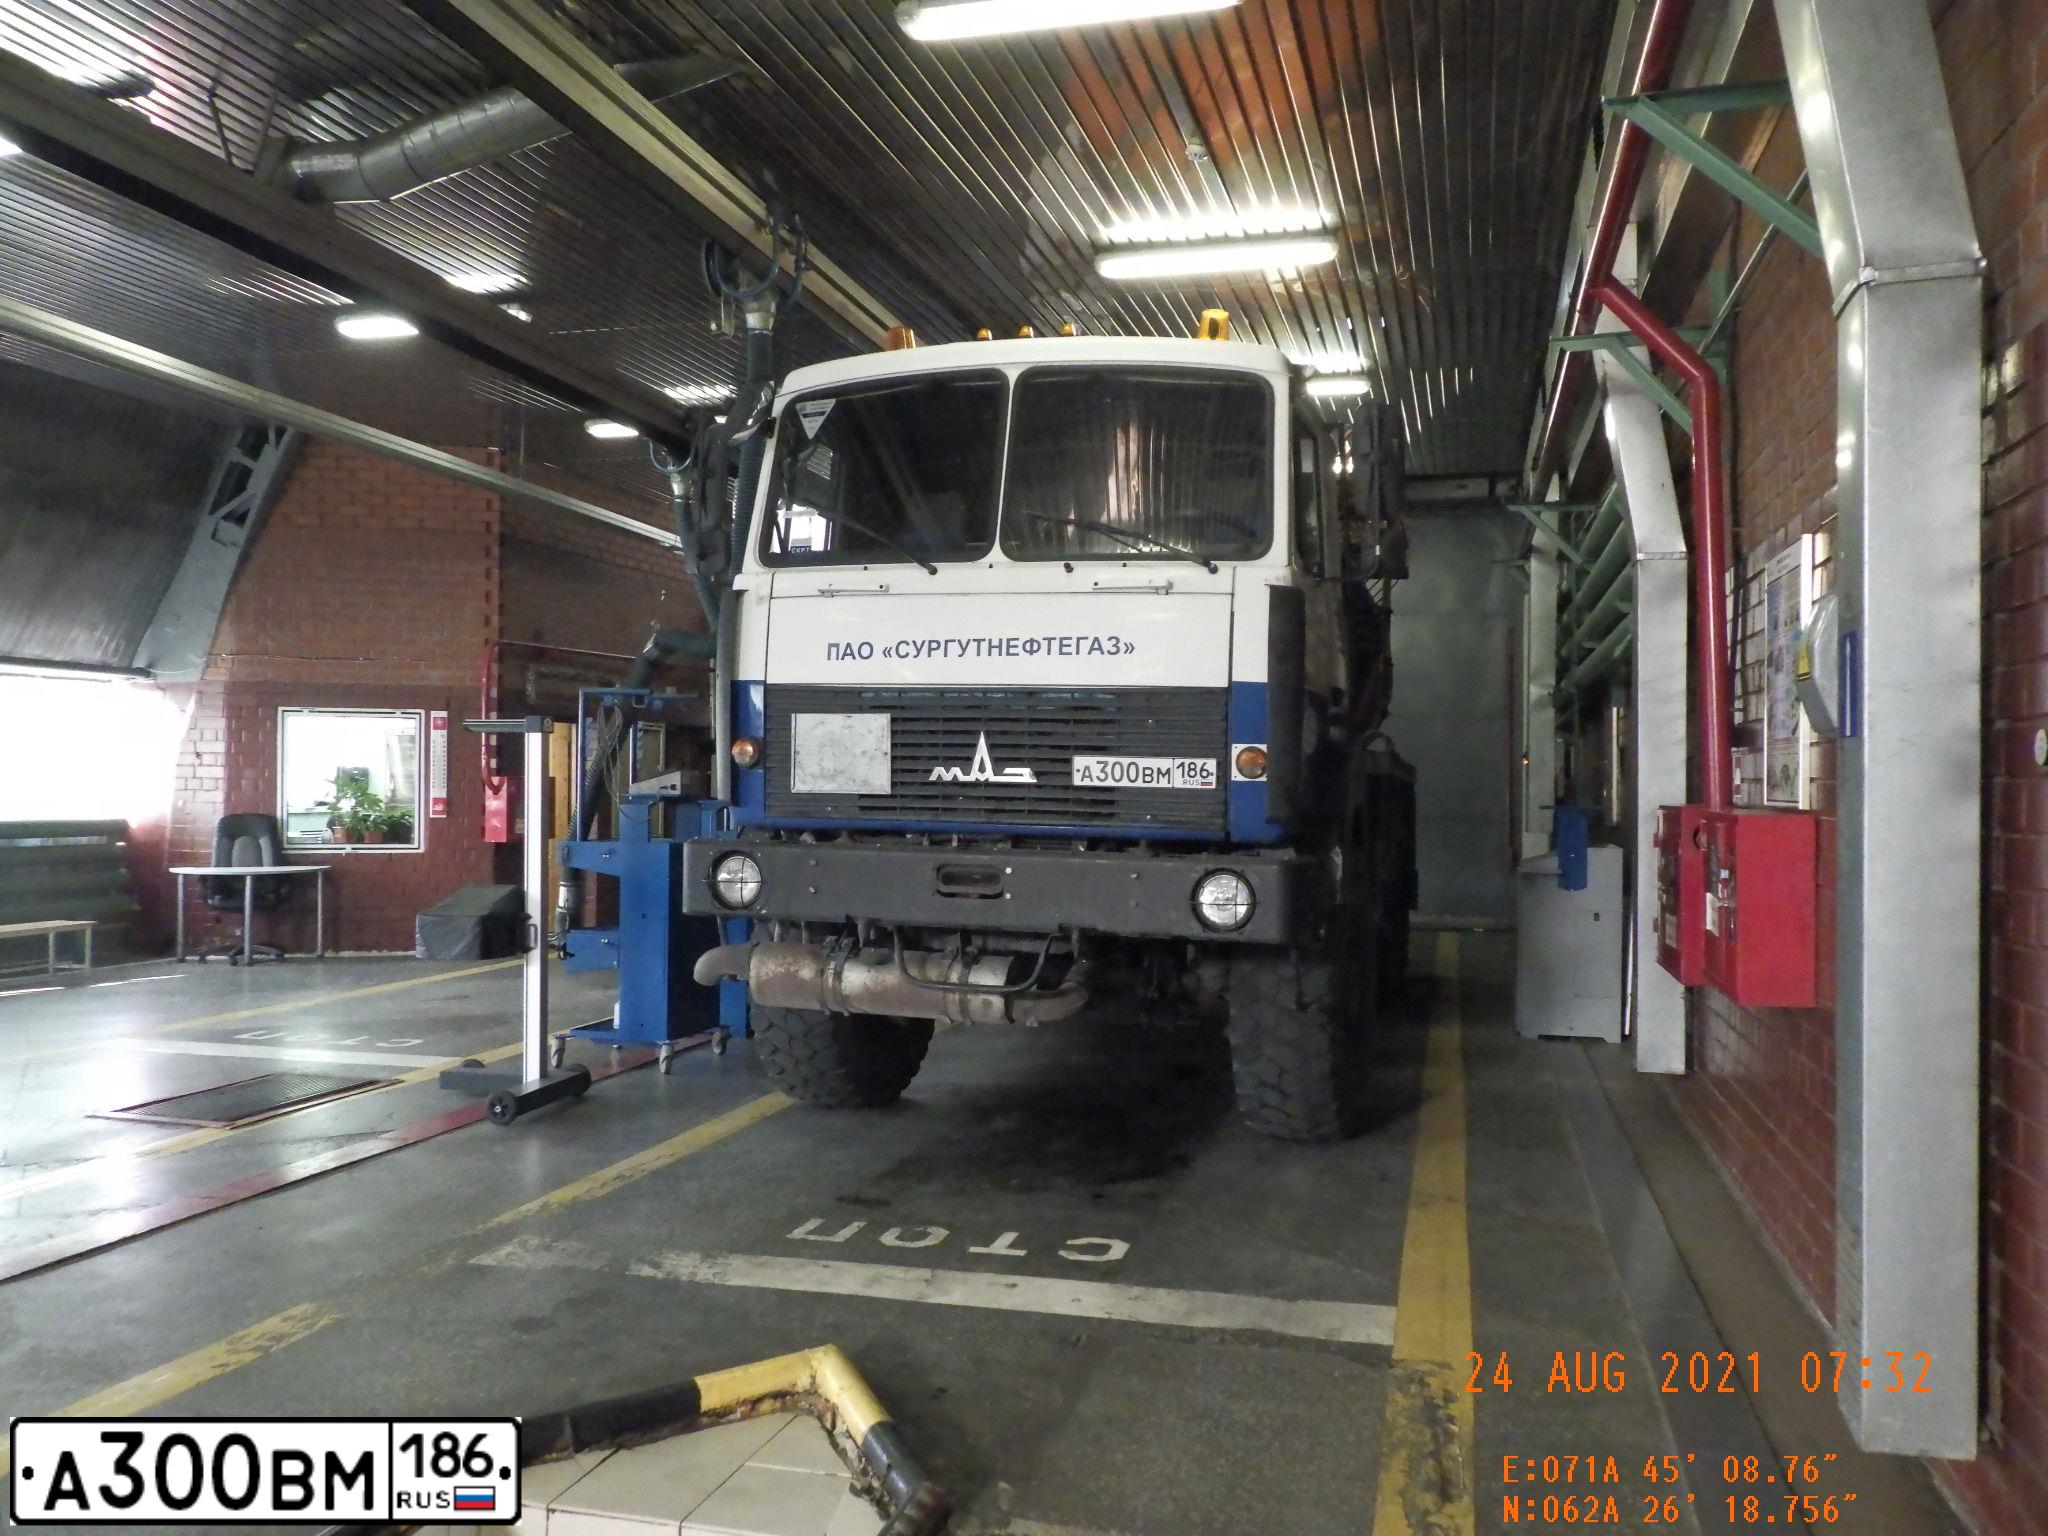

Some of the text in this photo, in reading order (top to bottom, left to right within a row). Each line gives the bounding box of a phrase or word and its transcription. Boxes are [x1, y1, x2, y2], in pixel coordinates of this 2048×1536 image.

[827, 635, 1136, 661] ПАО «СУРГУТНЕФТЕГАЗ»
[1080, 760, 1210, 785] А300ВМ 186
[785, 1218, 1131, 1262] СТОП
